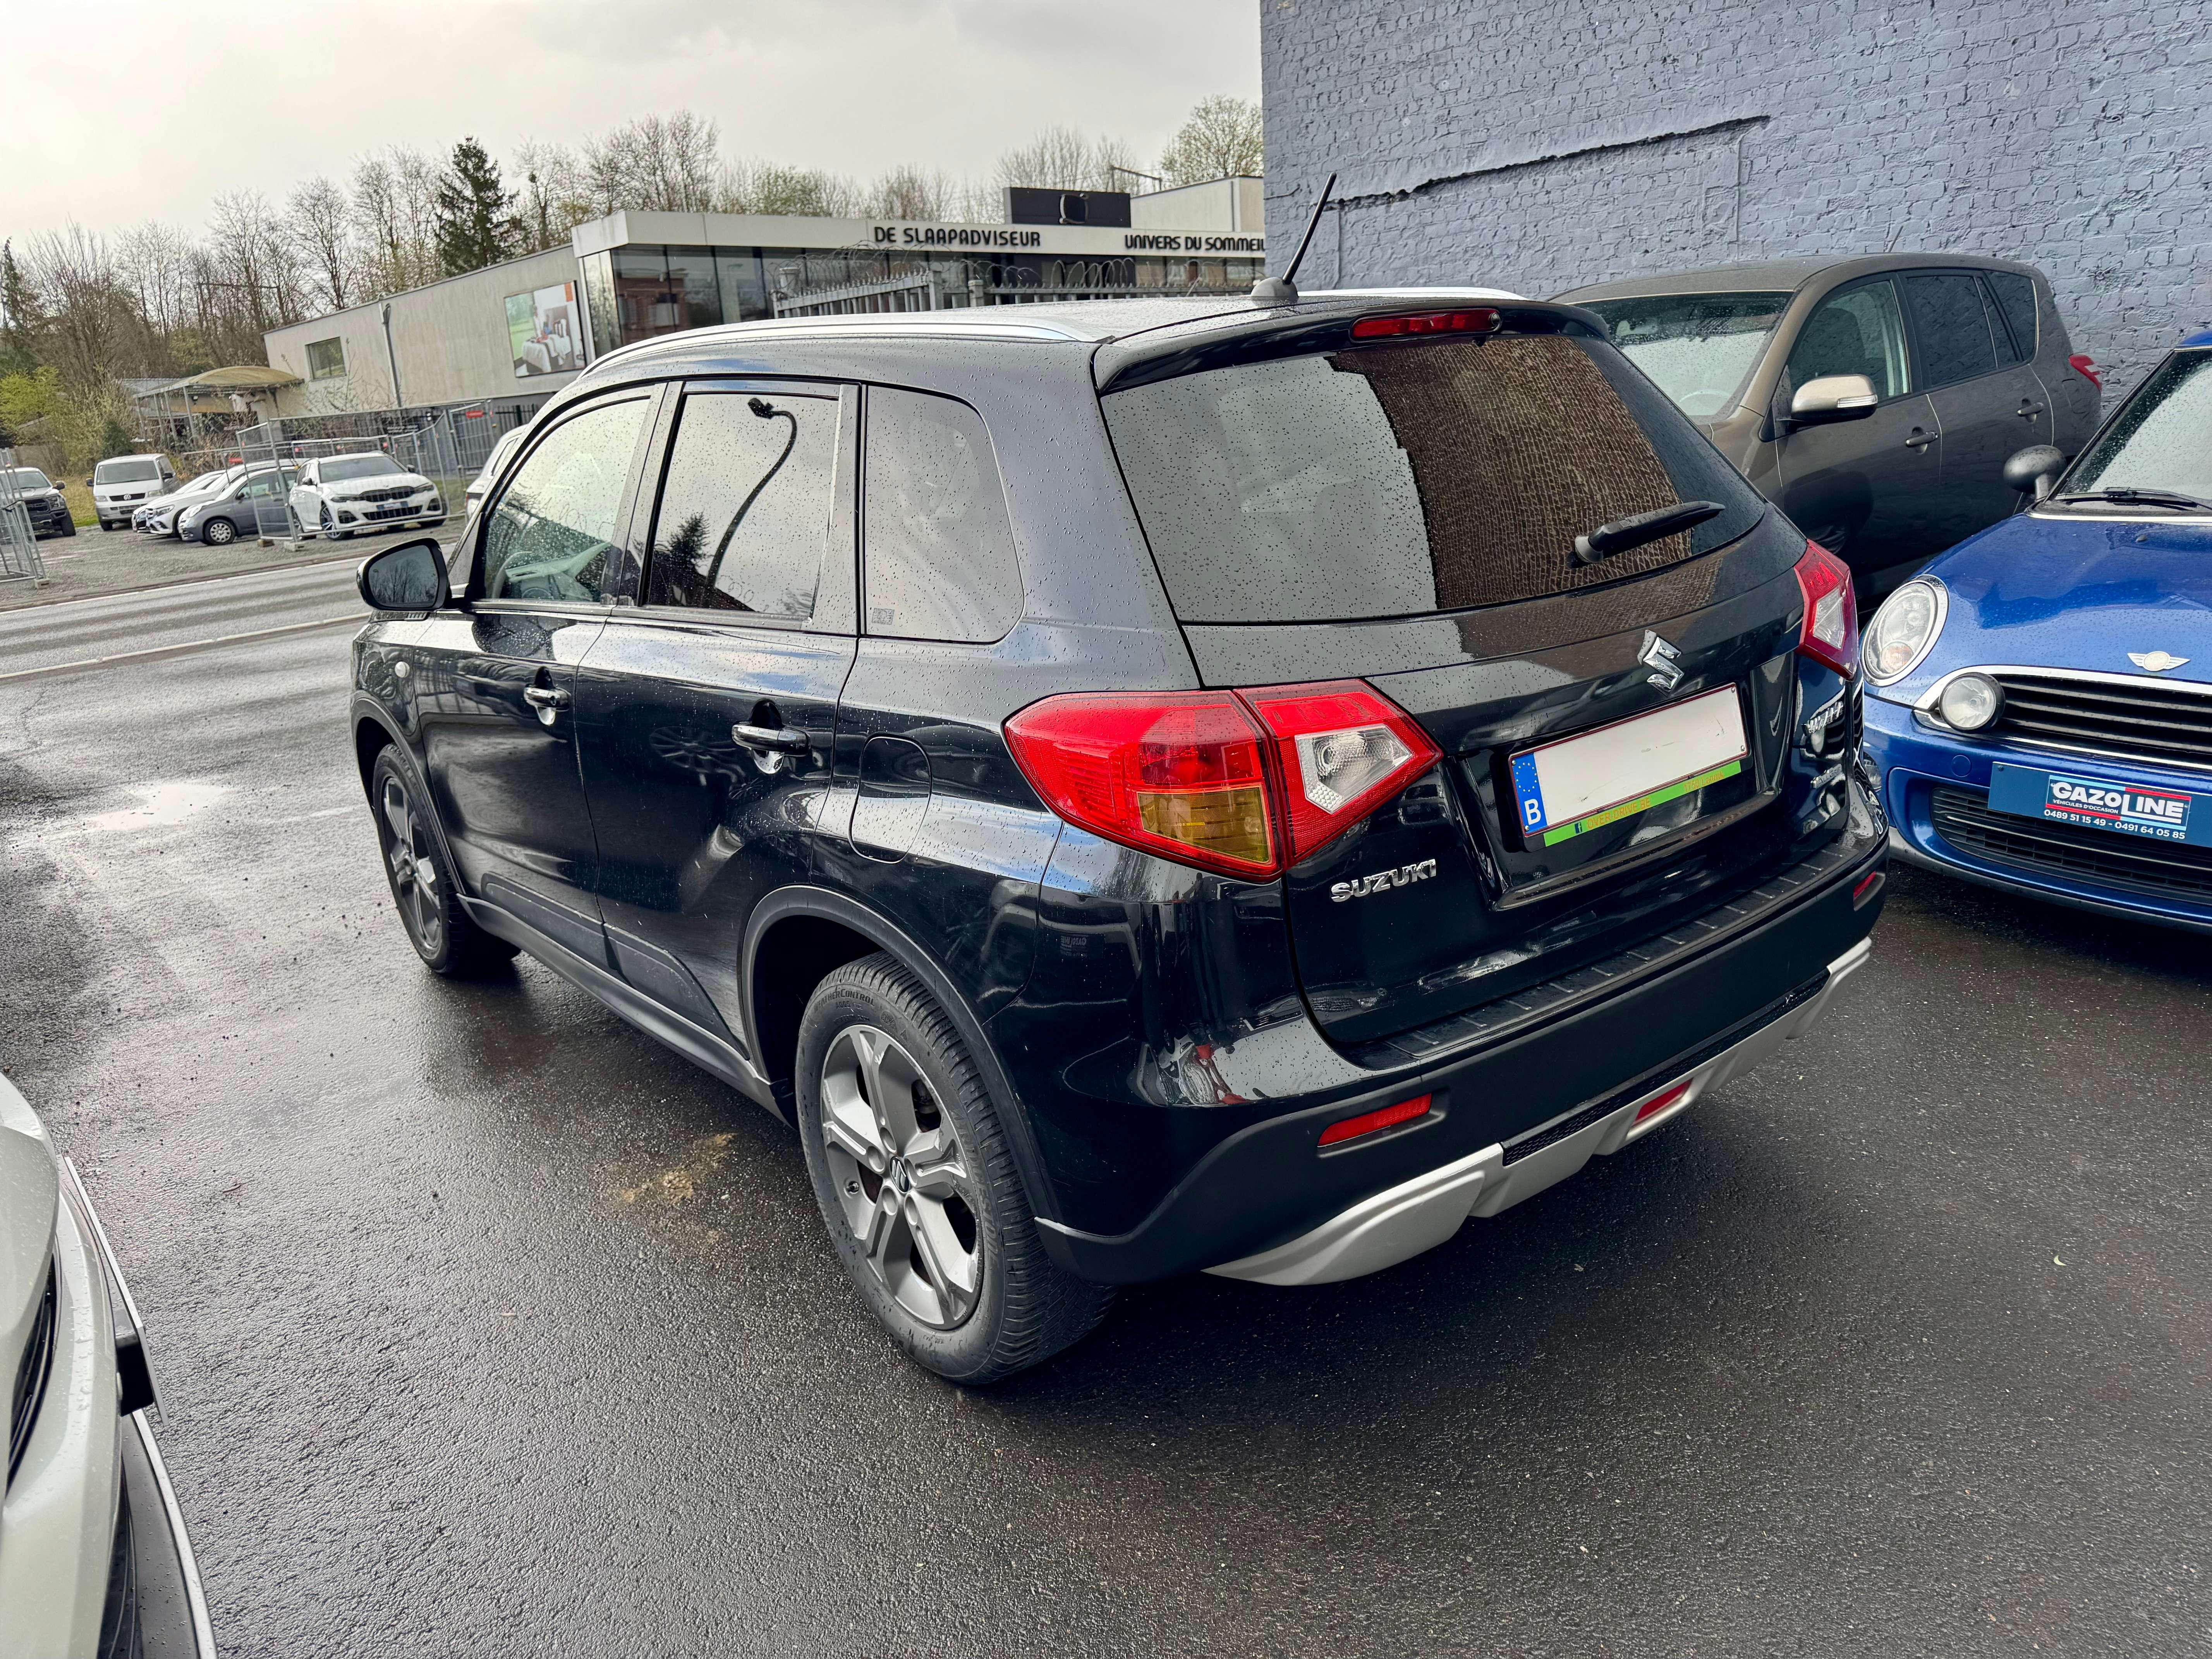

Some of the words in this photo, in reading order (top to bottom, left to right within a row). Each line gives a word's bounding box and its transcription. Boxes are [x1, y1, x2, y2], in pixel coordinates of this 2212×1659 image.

[874, 227, 896, 243] DE
[903, 228, 1041, 247] SLAAPADVISEUR
[1125, 234, 1181, 250] UNIVERS
[1185, 236, 1202, 250] DU
[1205, 237, 1265, 251] SOMMEIL
[1524, 799, 1541, 825] B
[2053, 781, 2184, 824] GAZOLINE
[2053, 799, 2082, 808] VÉHICULES
[2083, 804, 2119, 814] D'OCCASION
[2044, 809, 2068, 819] 0489
[2081, 816, 2091, 824] 15
[2115, 821, 2138, 832] 0491
[2140, 826, 2154, 835] 64
[2156, 829, 2170, 837] 05
[1331, 859, 1437, 902] SUZUKI
